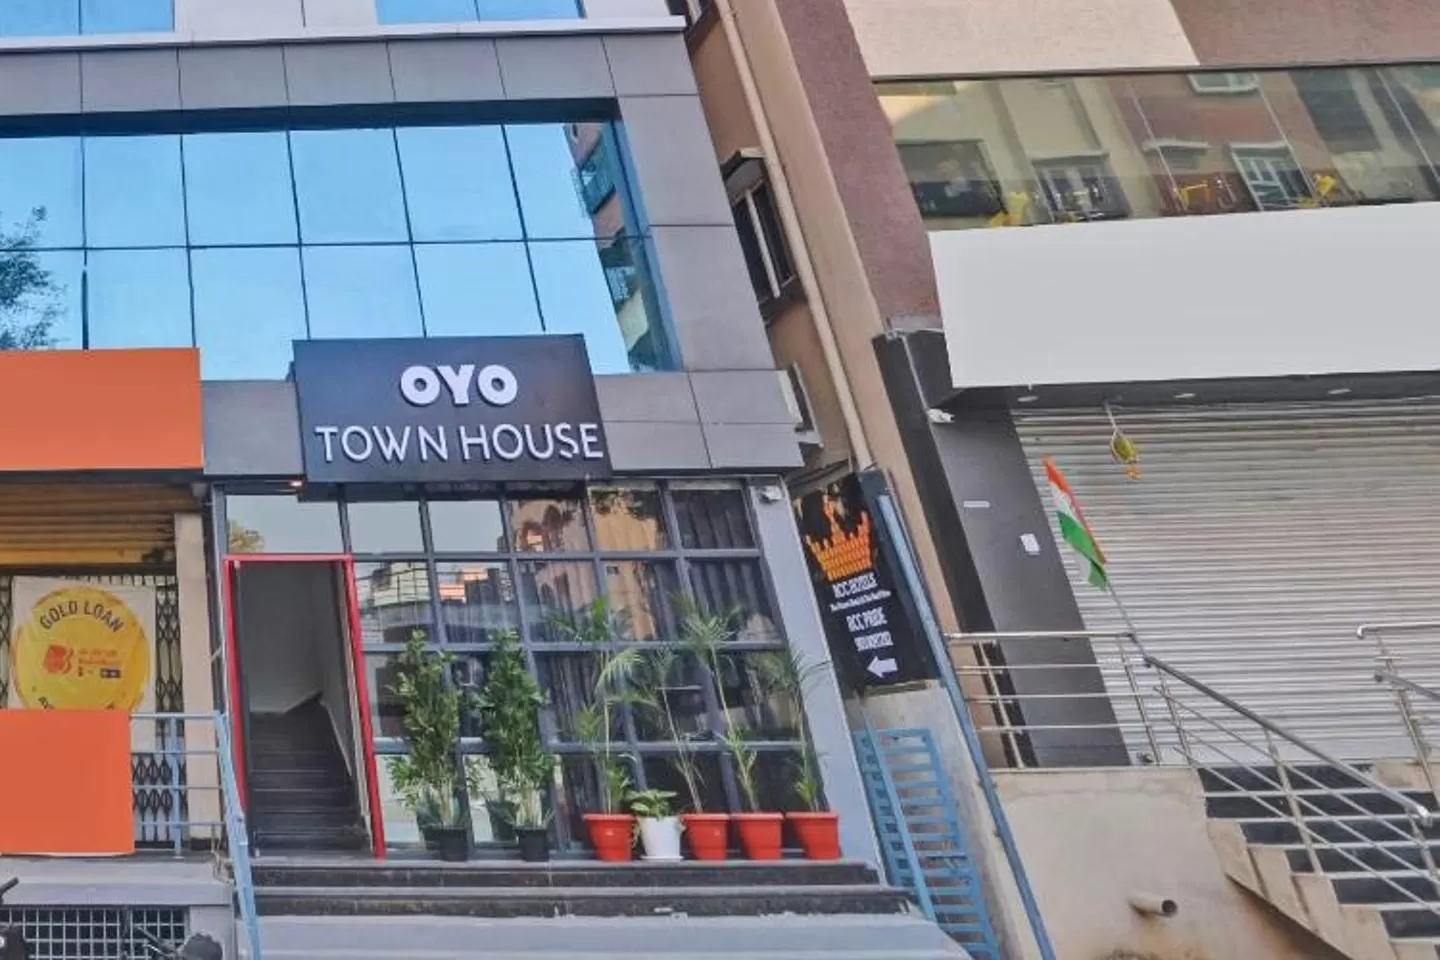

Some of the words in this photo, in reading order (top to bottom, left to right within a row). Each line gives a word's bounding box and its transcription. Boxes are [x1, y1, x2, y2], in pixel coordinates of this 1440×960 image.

[400, 364, 518, 406] OYO
[40, 600, 77, 629] GOLD
[84, 600, 124, 632] LOAN
